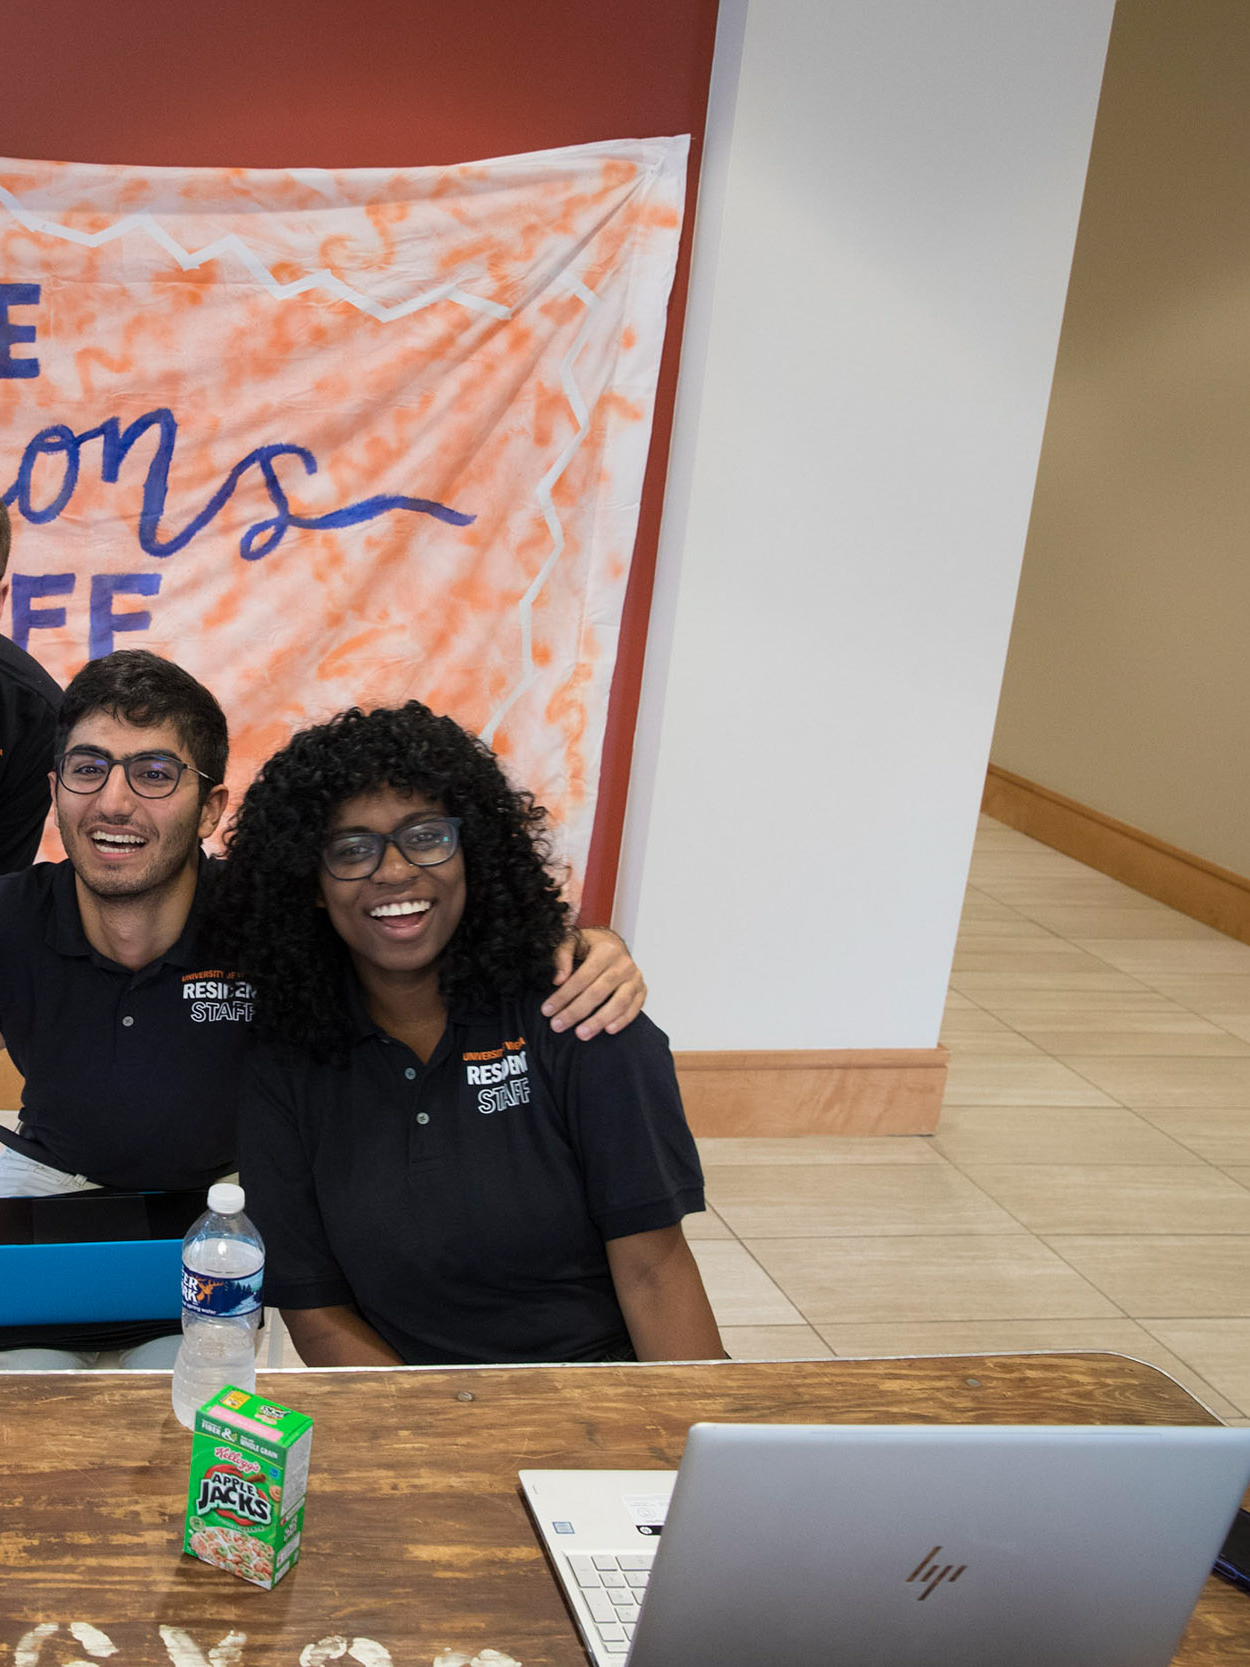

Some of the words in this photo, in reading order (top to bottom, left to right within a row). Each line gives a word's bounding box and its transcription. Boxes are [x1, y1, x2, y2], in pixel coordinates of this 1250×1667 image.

[214, 1446, 261, 1474] Kellogg's
[211, 1473, 256, 1496] APPLE
[198, 1480, 269, 1521] JACKS
